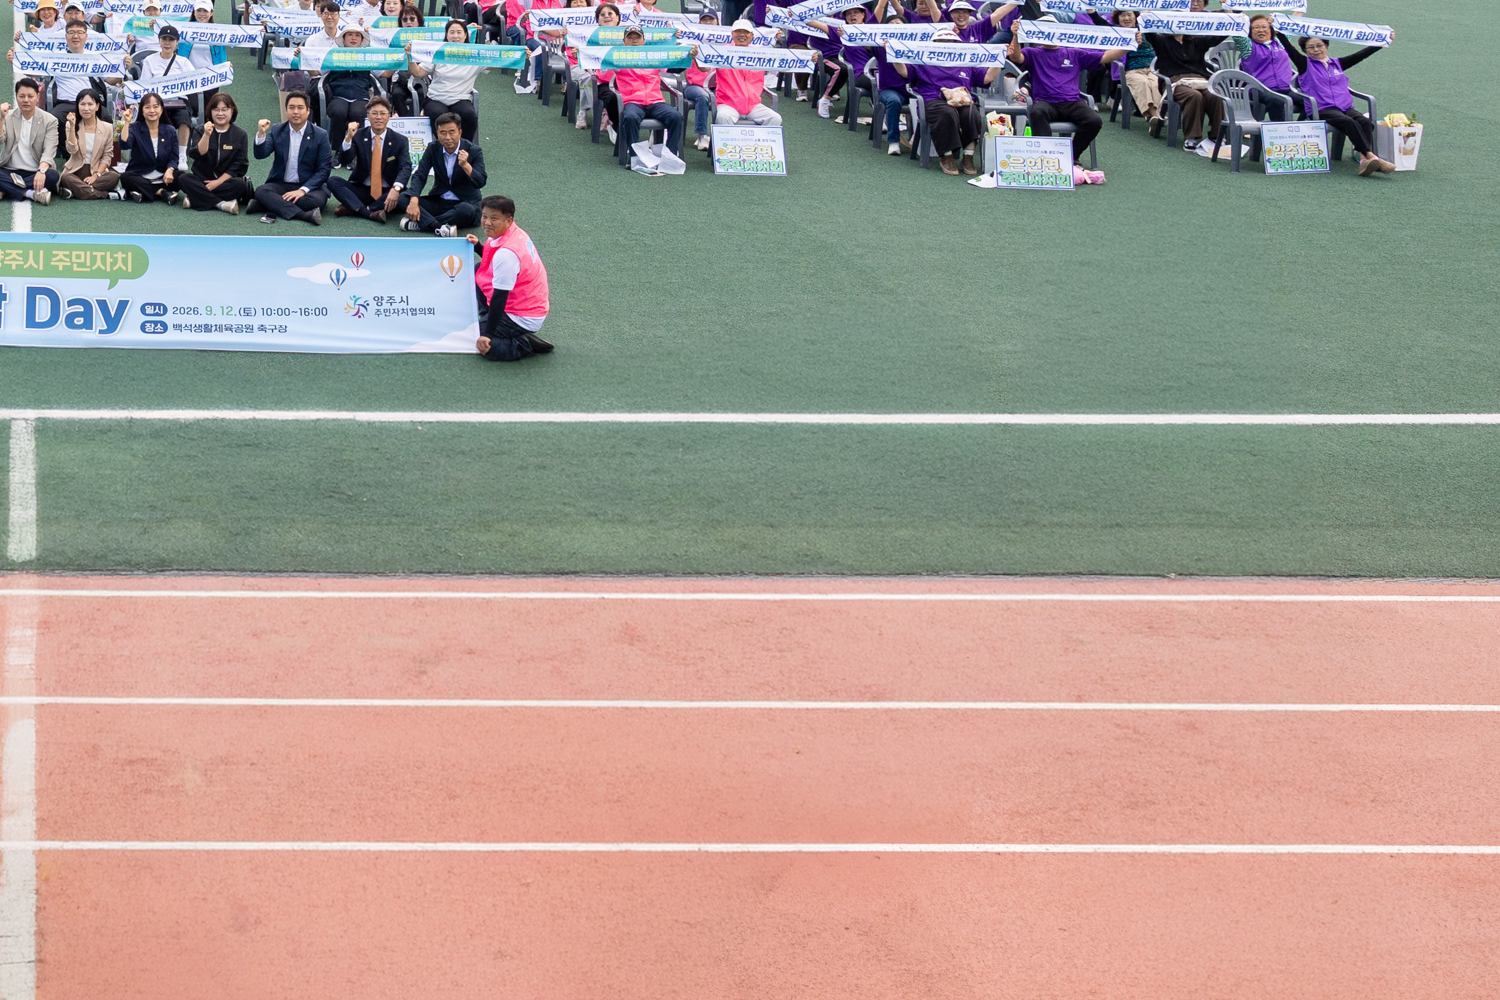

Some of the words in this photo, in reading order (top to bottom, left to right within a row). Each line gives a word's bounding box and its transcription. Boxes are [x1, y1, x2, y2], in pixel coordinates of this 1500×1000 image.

[798, 5, 825, 20] 양주시
[1160, 0, 1190, 10] 화이팅
[537, 16, 564, 27] 양주시
[1144, 18, 1173, 30] 양주시
[1176, 20, 1212, 31] 주민자치
[1214, 19, 1245, 31] 화이팅
[190, 31, 227, 43] 주민자치
[228, 33, 258, 44] 화이팅
[1025, 29, 1055, 42] 양주시
[1056, 32, 1098, 45] 주민자치
[1099, 35, 1132, 47] 화이팅
[1278, 20, 1310, 34] 양주시
[1312, 25, 1352, 39] 주민자치
[1358, 30, 1388, 43] 화이팅
[27, 41, 53, 51] 양주시
[95, 41, 124, 51] 화이팅
[704, 53, 734, 66] 양주시
[736, 56, 776, 67] 주민자치
[777, 58, 809, 69] 화이팅
[894, 49, 924, 62] 양주시
[926, 51, 966, 63] 주민자치
[968, 52, 999, 63] 화이팅
[20, 60, 49, 73] 양주시
[50, 61, 89, 73] 주민자치
[91, 63, 121, 73] 화이팅
[161, 80, 198, 95] 주민자치
[200, 72, 228, 88] 화이팅
[726, 144, 773, 160] 장흥면
[1273, 141, 1320, 158] 양주1동
[718, 158, 784, 173] 주민자치회
[1009, 156, 1060, 173] 은현면
[1270, 156, 1328, 171] 주민자치회
[1001, 171, 1071, 187] 주민자치회
[50, 250, 133, 273] 주민자치
[372, 295, 410, 307] 양주시
[25, 284, 132, 335] Day
[145, 305, 164, 314] 일시
[172, 306, 202, 316] 2026.
[205, 305, 217, 316] 9.
[261, 306, 328, 317] 10:00~16:00
[374, 307, 436, 317] 주민자치협의회
[145, 323, 164, 333] 장소
[172, 323, 255, 334] 백석생활체육공원
[257, 323, 288, 334] 축구장
